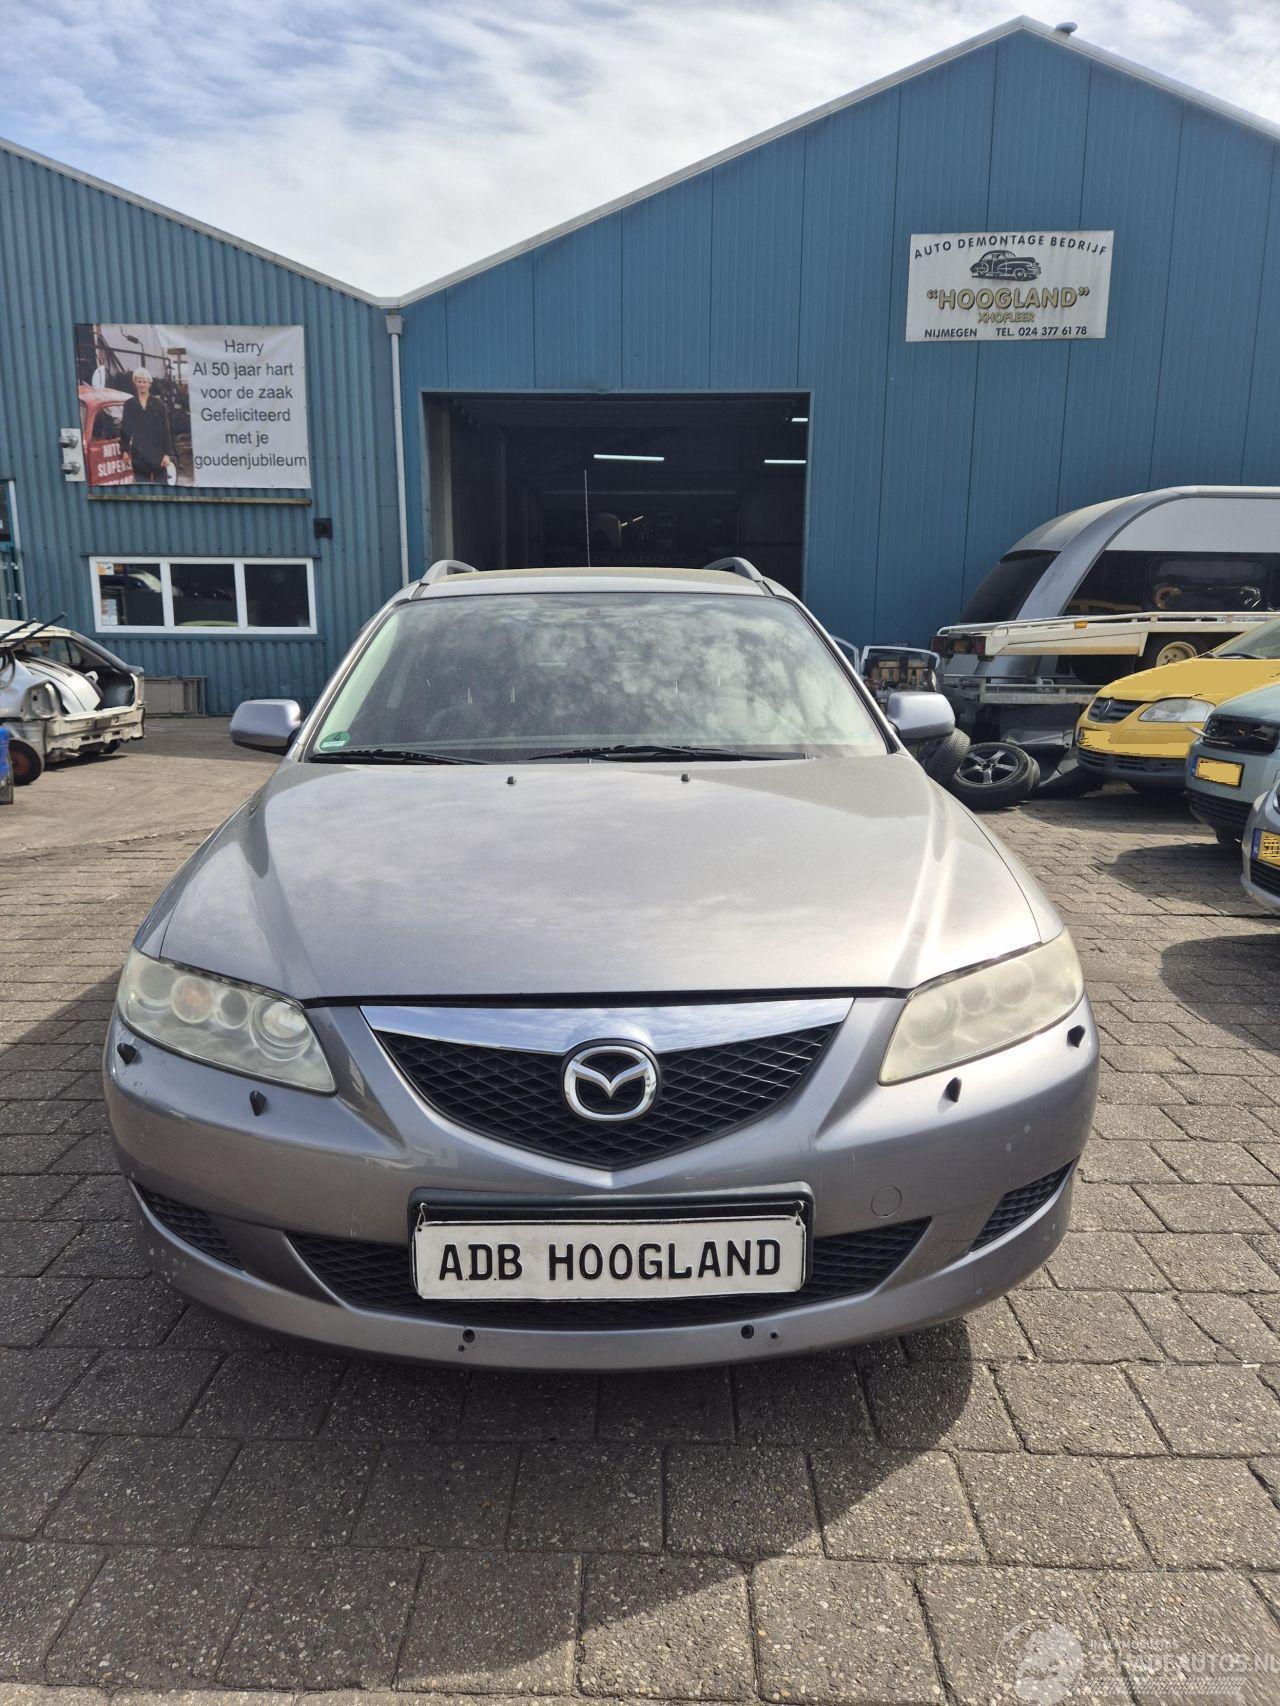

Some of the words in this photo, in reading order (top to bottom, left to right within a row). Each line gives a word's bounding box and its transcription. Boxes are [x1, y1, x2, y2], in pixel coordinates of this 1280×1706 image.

[914, 240, 952, 259] AUTO
[957, 235, 1045, 249] DEMONTAGE
[1050, 235, 1108, 255] BEDRIJF
[924, 328, 978, 338] NIJMEGEN
[996, 327, 1015, 337] TEL.
[1018, 326, 1038, 336] 024
[1041, 326, 1058, 336] 377
[1061, 326, 1072, 335] 61
[1075, 326, 1087, 335] 78
[224, 339, 264, 356] Harry
[193, 362, 207, 376] Al
[212, 362, 230, 376] 50
[233, 362, 261, 379] jaar
[265, 361, 293, 376] hart
[200, 388, 232, 399] voor
[236, 385, 254, 399] de
[258, 385, 293, 399] zaak
[201, 407, 291, 422] Gefeliciteerd
[225, 431, 252, 444] met
[255, 431, 269, 447] je
[194, 453, 307, 469] goudenjubileum
[549, 1239, 781, 1281] HOOGLAND
